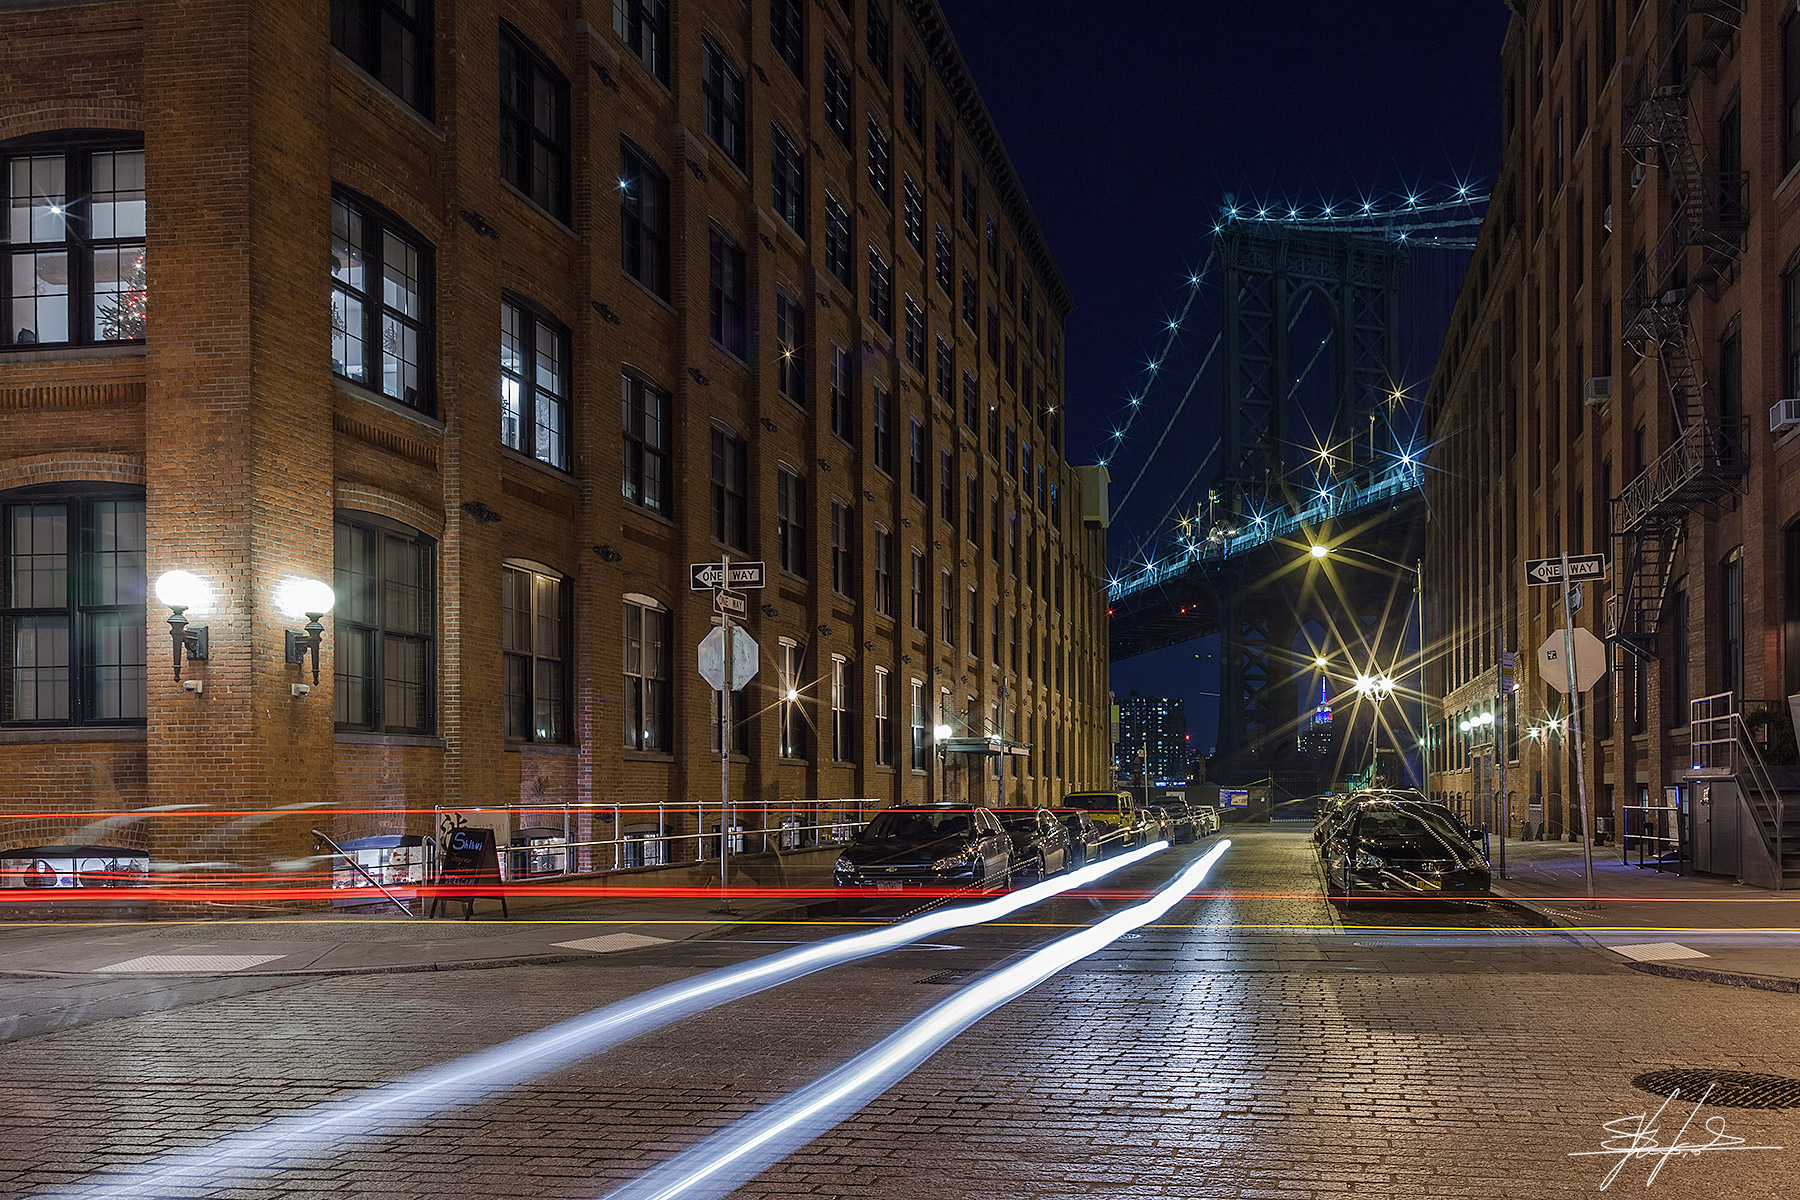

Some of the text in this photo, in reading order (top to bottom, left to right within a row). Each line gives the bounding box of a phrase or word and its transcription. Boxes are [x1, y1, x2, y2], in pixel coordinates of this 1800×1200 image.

[702, 570, 754, 581] ONE WAY
[1538, 563, 1593, 577] ONE WAY
[733, 600, 743, 610] WAY
